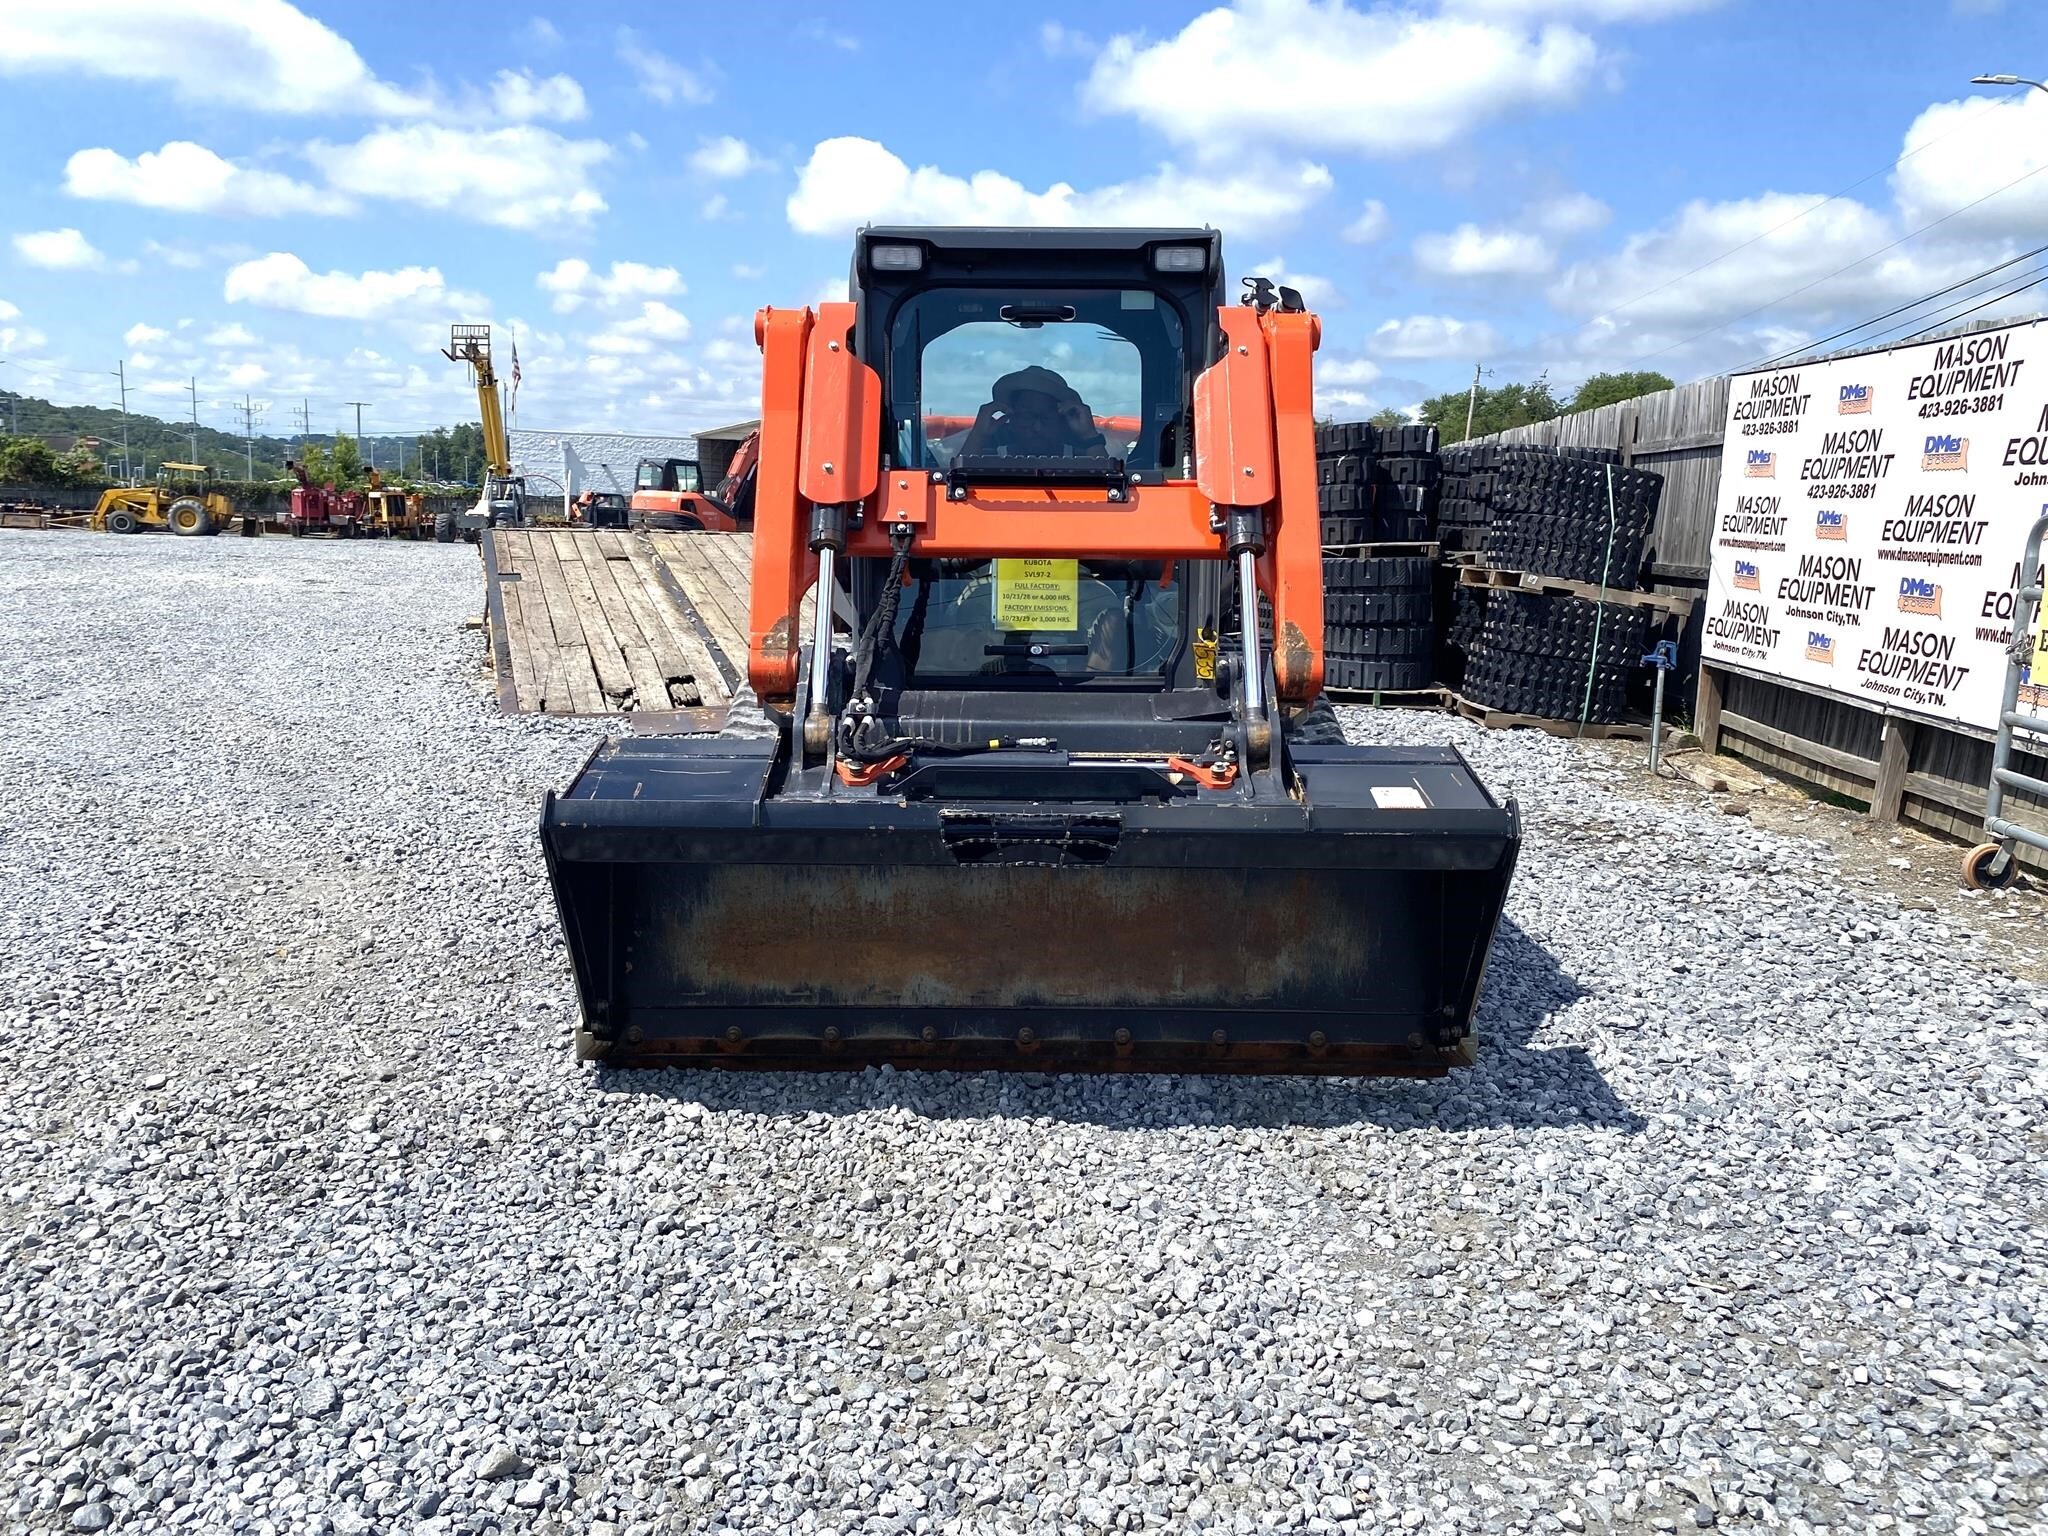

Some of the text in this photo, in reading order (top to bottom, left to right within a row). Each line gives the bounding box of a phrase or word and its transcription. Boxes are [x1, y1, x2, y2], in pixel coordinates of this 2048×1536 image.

[1935, 334, 2009, 370] MASON
[1751, 374, 1800, 398] MASON
[1908, 360, 2024, 400] EQUIPMENT
[1733, 395, 1811, 420] EQUIPMENT
[1918, 394, 2004, 419] 423-926-3881
[1741, 420, 1799, 436] 423-926-3881
[1821, 428, 1883, 455] MASON
[1801, 454, 1895, 480] EQUIPMENT
[2014, 472, 2048, 486] John
[1807, 483, 1876, 499] 423-926-3881
[1736, 496, 1781, 515] MASON
[1904, 494, 1976, 518] MASON
[1722, 516, 1787, 536] EQUIPMENT
[1882, 520, 1988, 545] EQUIPMENT
[1798, 555, 1861, 581] MASON
[1877, 547, 1982, 567] www.dmasonequipment.com
[1778, 578, 1875, 611] EQUIPMENT
[1723, 600, 1769, 625] MASON
[1786, 605, 1823, 620] Johnson
[1706, 617, 1780, 649] EQUIPMENT
[1882, 627, 1955, 661] MASON
[1713, 640, 1739, 653] Johnson
[1858, 649, 1969, 692] EQUIPMENT
[1861, 678, 1902, 696] Johnson
